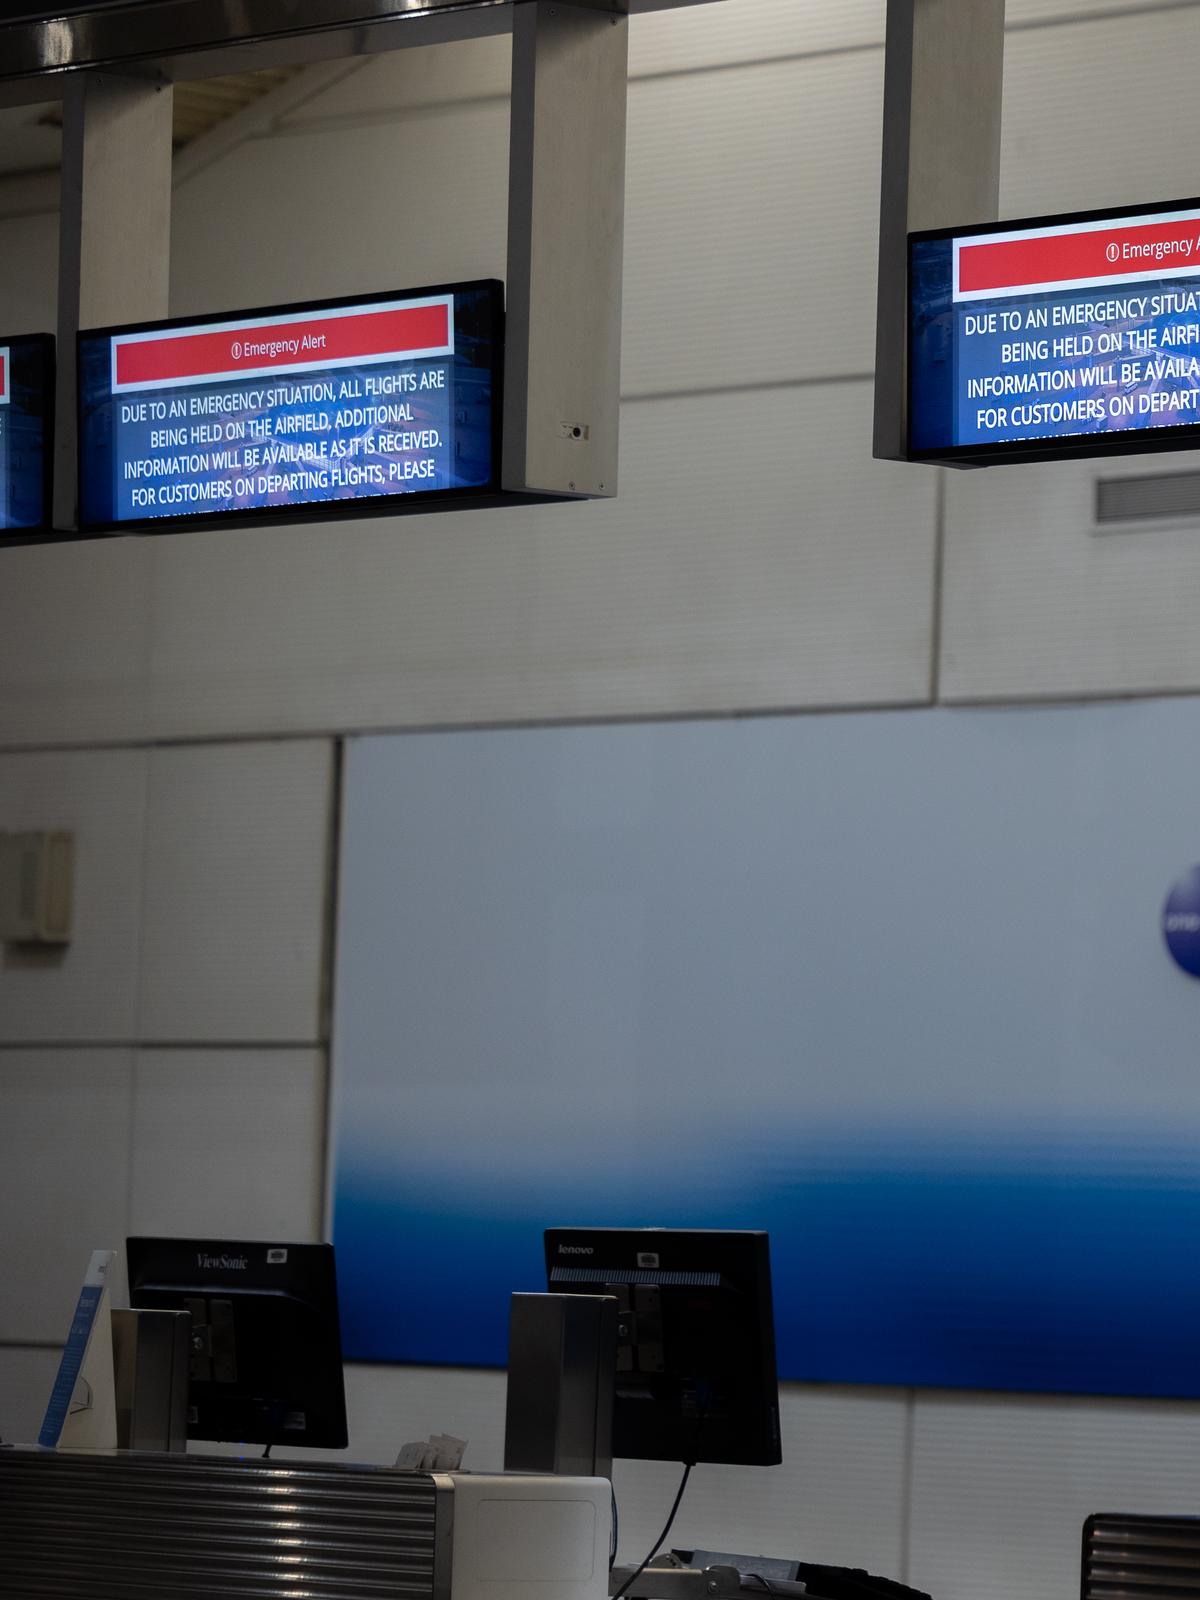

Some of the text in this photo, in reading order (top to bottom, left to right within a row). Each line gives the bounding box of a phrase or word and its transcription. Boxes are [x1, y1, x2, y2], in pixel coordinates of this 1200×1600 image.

[1122, 235, 1193, 259] Emergency
[965, 313, 996, 335] DUE
[999, 310, 1021, 331] TO
[1025, 307, 1047, 329] AN
[1052, 296, 1147, 326] EMERGENCY
[244, 332, 325, 357] Emergency Alert
[1001, 339, 1048, 363] BEING
[1052, 334, 1093, 357] HELD
[1097, 331, 1122, 353] ON
[1125, 328, 1157, 350] THE
[121, 370, 444, 423] DUE TO AN EMERGENCY SITUATION, ALL FLIGHTS ARE
[967, 368, 1075, 398] INFORMATION
[1079, 364, 1117, 387] WILL
[1121, 362, 1140, 383] BE
[150, 403, 413, 448] BEING HELD ON THE AIRFIELD. ADDITIONAL
[976, 407, 1007, 429] FOR
[1010, 397, 1105, 426] CUSTOMERS
[1109, 394, 1135, 416] ON
[124, 430, 442, 479] INFORMATION WILL BE AVAILABLE AS IT IS RECEIVED.
[131, 461, 434, 506] FOR CUSTOMERS ON DEPARTING FLIGHTS, PLEASE
[196, 1253, 248, 1269] ViewSonic
[558, 1243, 593, 1255] lenovo
